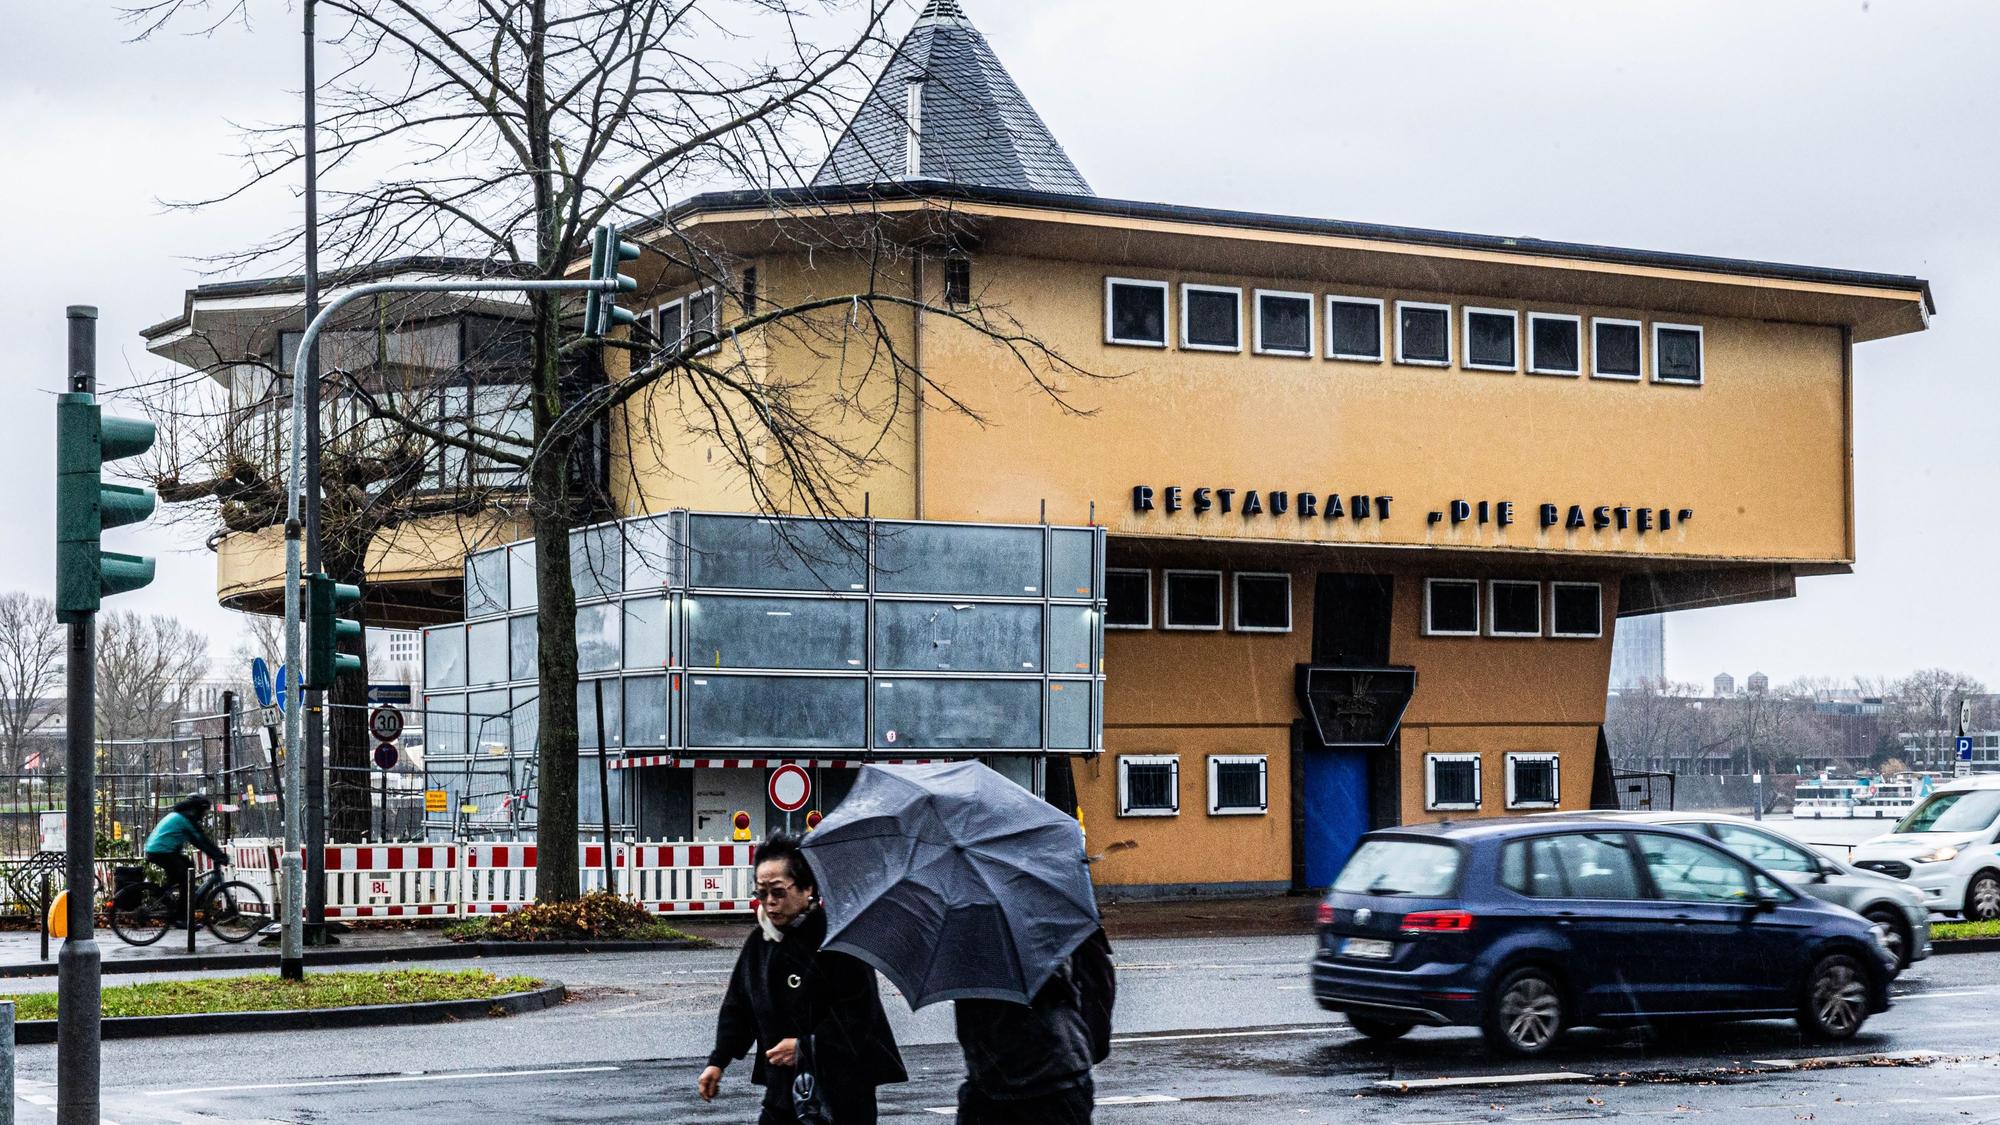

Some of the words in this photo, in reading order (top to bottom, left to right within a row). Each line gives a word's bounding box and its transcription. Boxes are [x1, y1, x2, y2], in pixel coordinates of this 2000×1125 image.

[1132, 485, 1393, 521] RESTAURANT
[377, 715, 397, 732] 30
[1960, 739, 1969, 755] P
[372, 881, 389, 894] BL
[704, 878, 720, 890] BL
